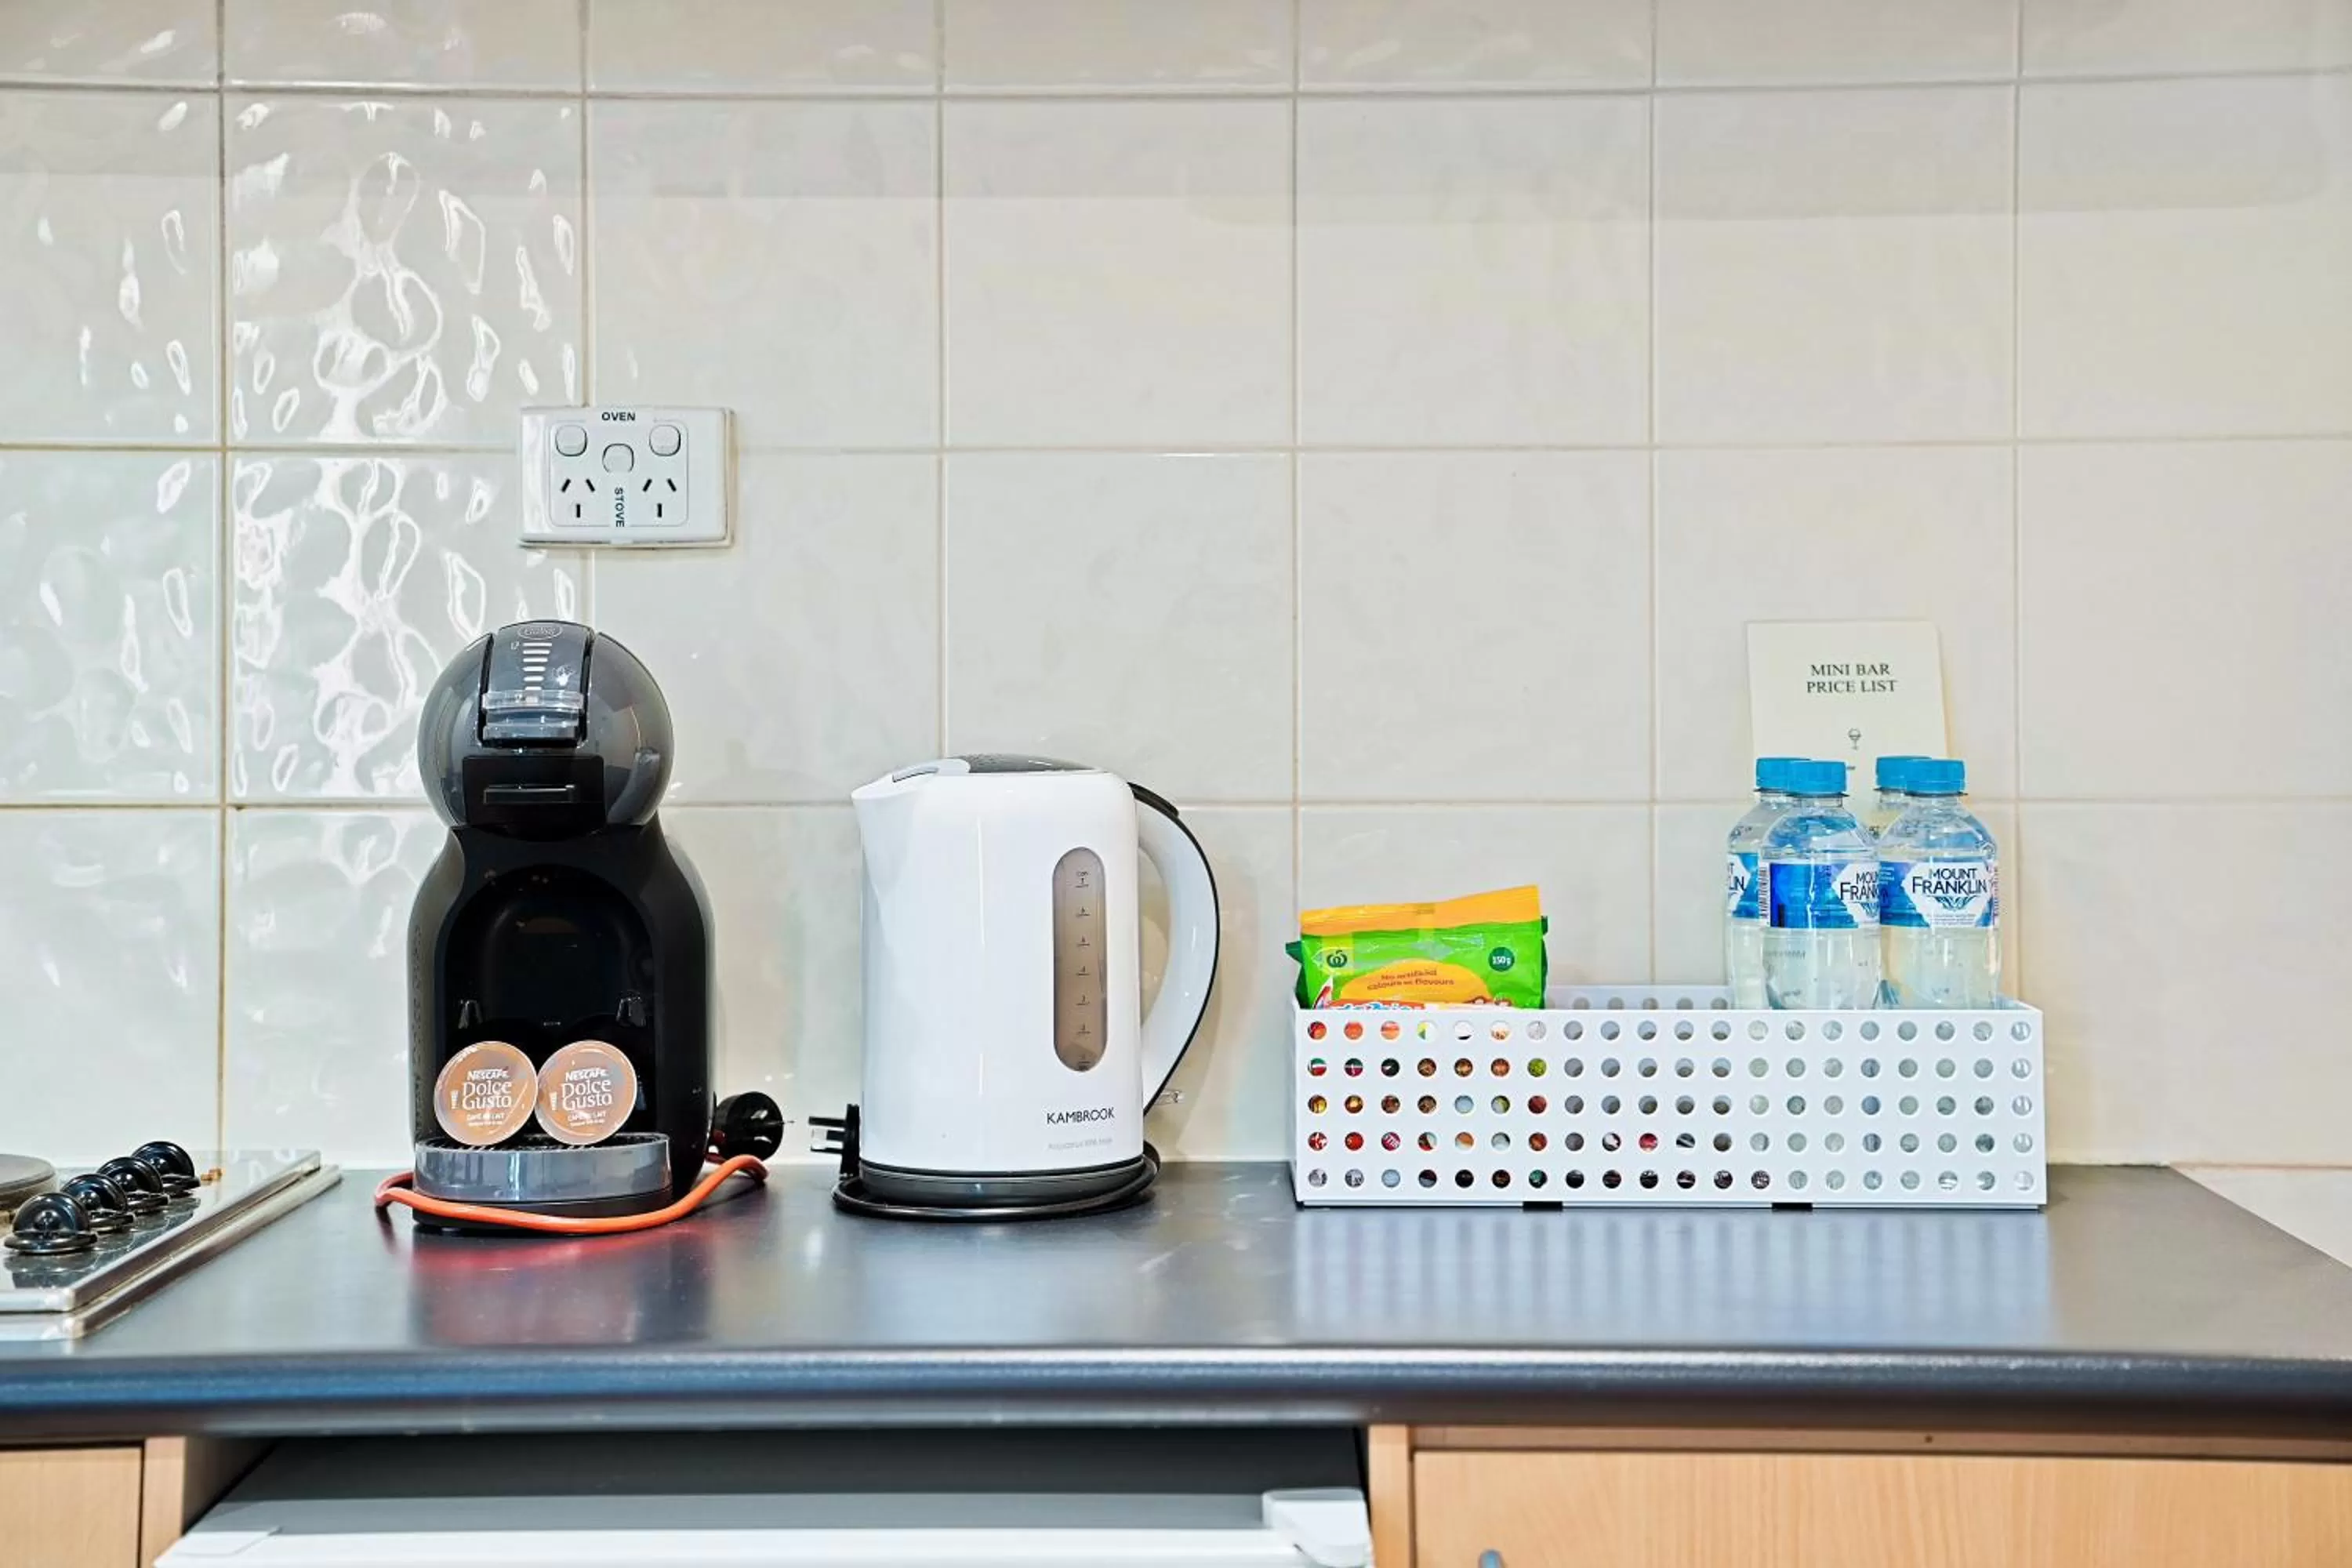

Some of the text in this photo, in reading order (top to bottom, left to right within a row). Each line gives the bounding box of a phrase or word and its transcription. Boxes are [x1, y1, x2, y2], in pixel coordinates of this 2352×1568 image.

[601, 412, 636, 422] OVEN
[614, 487, 625, 528] STOVE
[1810, 662, 1891, 677] MINI BAR
[1806, 680, 1897, 694] PRICE LIST
[1856, 872, 1879, 884] MOU
[1929, 868, 1977, 880] MOUNT
[1911, 876, 1987, 895] FRANKLIN
[463, 1080, 513, 1096] Dolce
[561, 1080, 612, 1098] Dolce
[463, 1094, 512, 1110] Gusto
[562, 1093, 612, 1111] Gusto
[1047, 1106, 1116, 1125] KAMBROOK
